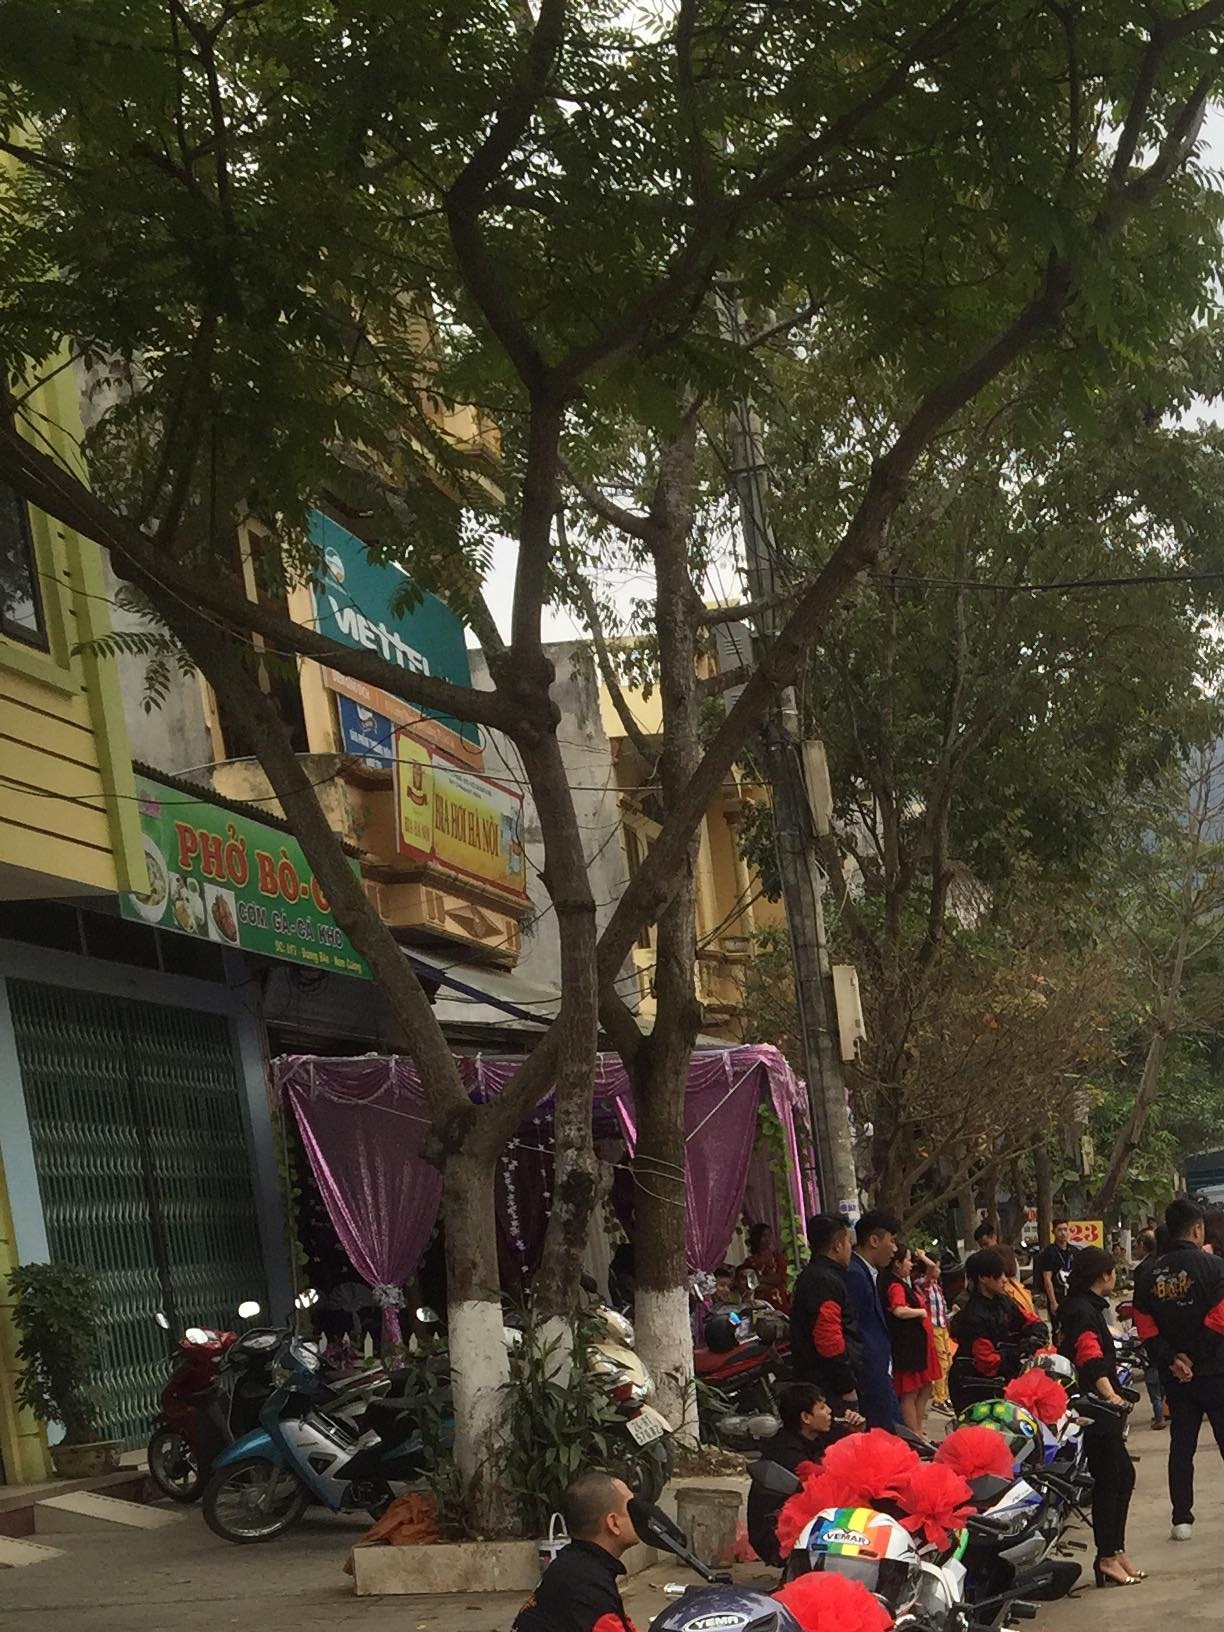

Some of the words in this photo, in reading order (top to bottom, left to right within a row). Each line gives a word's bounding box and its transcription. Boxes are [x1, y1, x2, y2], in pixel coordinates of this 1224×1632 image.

[174, 820, 249, 888] PHỞ
[827, 1533, 866, 1544] VEMAR
[695, 1615, 740, 1629] YEMA
